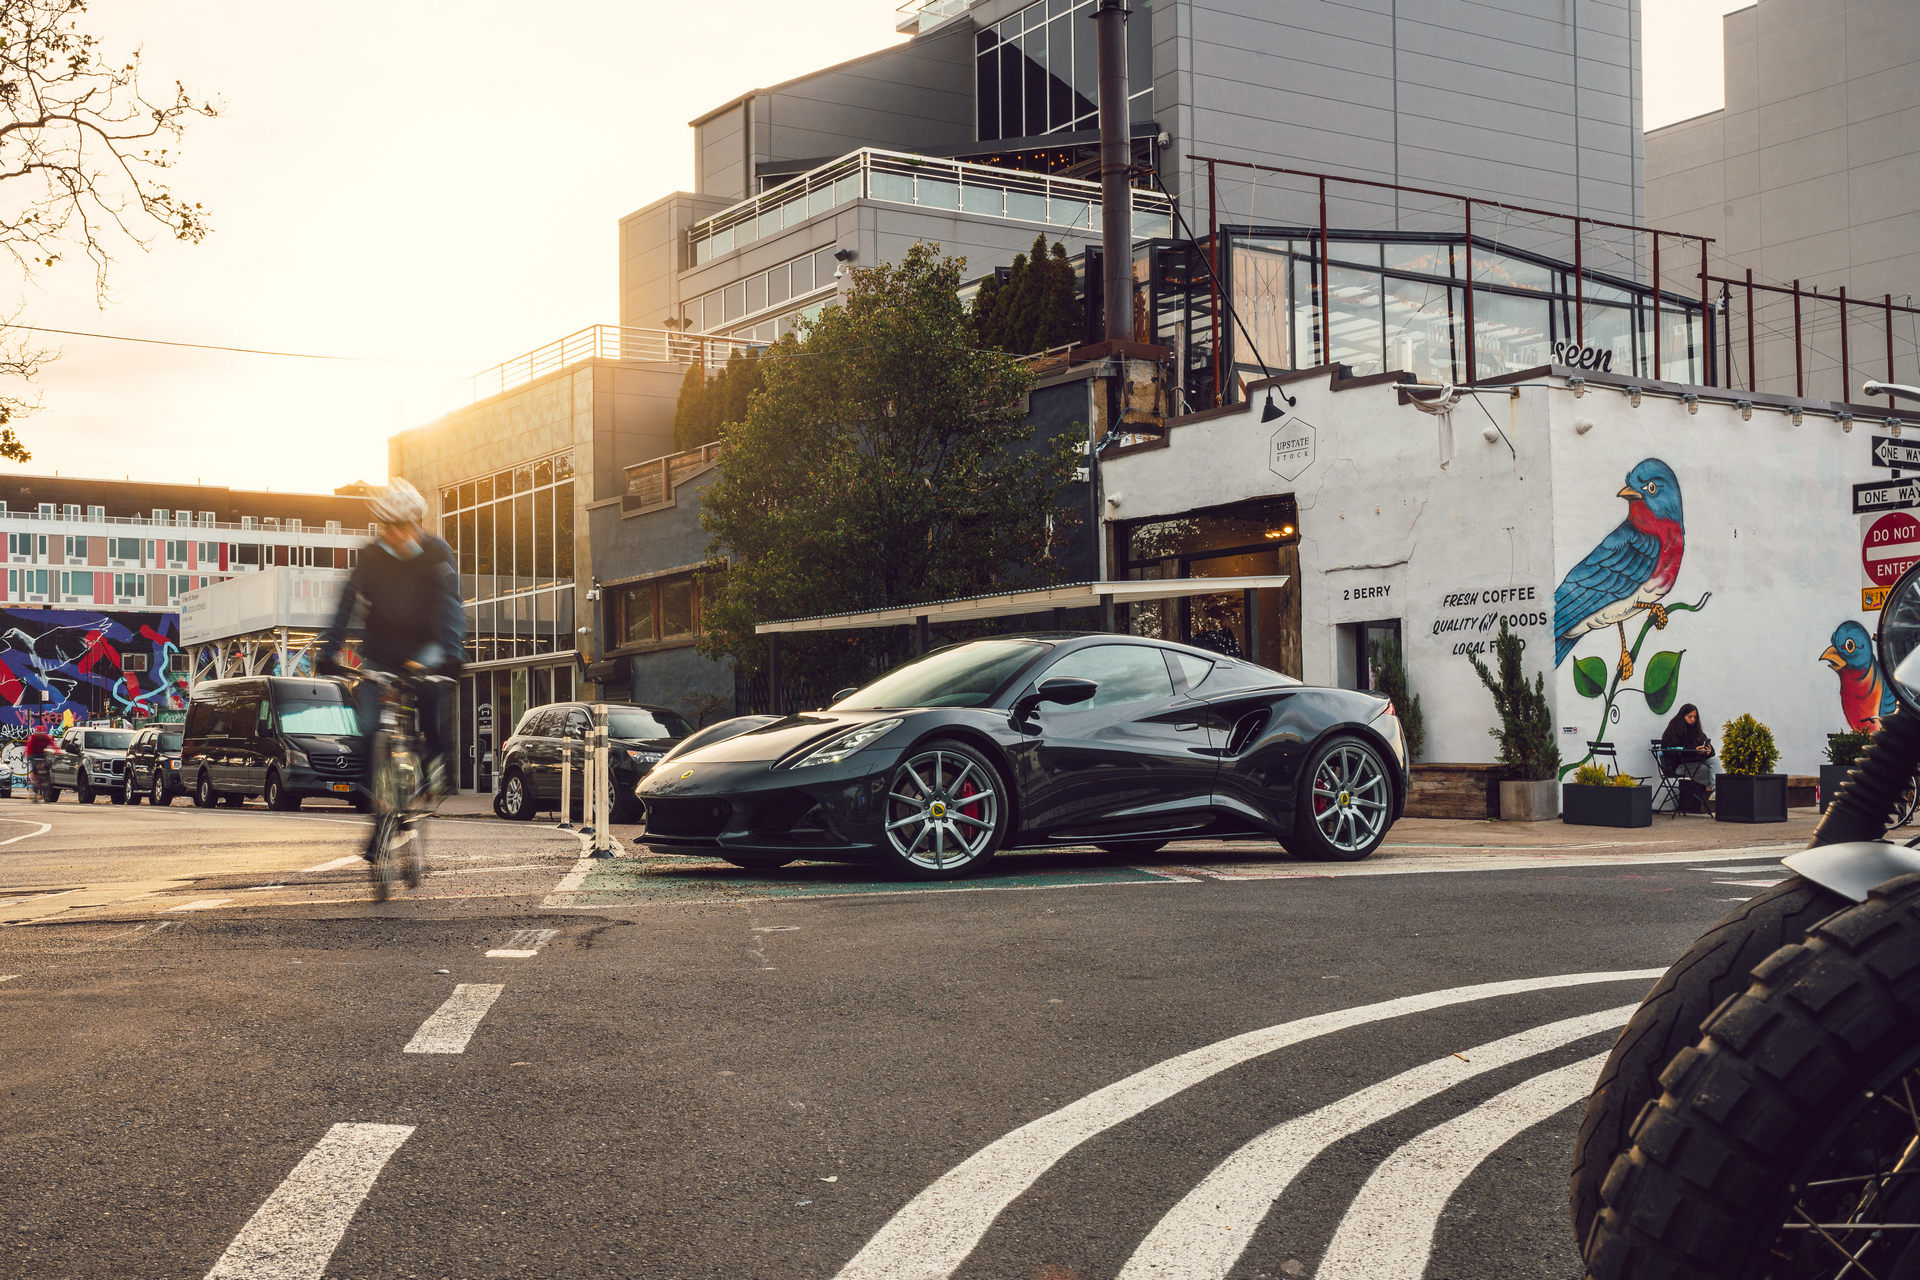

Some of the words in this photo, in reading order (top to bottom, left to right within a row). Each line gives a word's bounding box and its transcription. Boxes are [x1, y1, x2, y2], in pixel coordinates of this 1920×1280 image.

[1276, 437, 1309, 451] UPSTATE
[1276, 450, 1309, 462] STOCK
[1881, 446, 1898, 460] ONE
[1864, 490, 1888, 504] ONE
[1873, 529, 1889, 542] DO
[1893, 525, 1916, 540] NOT
[1343, 589, 1350, 601] 2
[1353, 584, 1391, 600] BERRY
[1443, 592, 1478, 607] FRESH
[1482, 587, 1535, 603] COFFEE
[1433, 617, 1479, 634] QUALITY
[1452, 640, 1486, 655] LOCAL
[1489, 638, 1526, 653] FD
